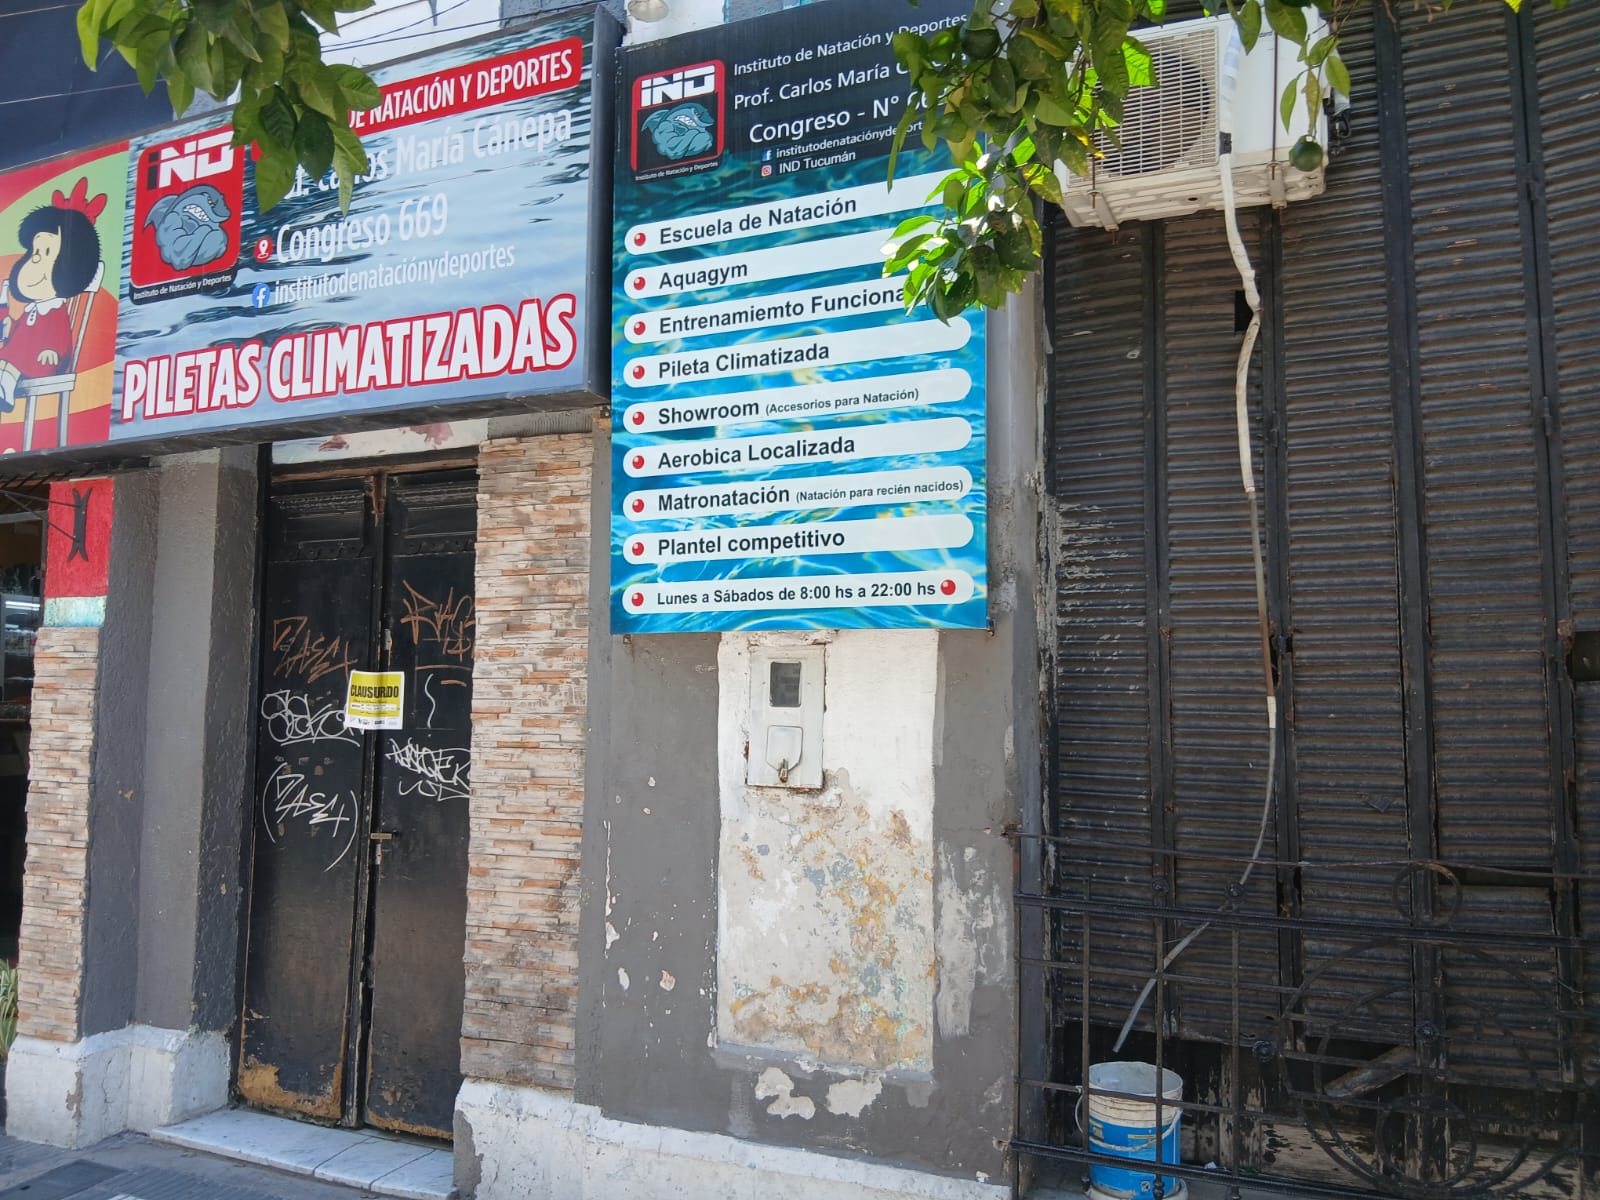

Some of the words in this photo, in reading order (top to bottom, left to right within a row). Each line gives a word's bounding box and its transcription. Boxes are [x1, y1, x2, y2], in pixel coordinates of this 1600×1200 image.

[734, 54, 791, 76] Instituto
[795, 48, 813, 62] de
[817, 32, 881, 57] Natación
[885, 32, 894, 45] y
[369, 76, 455, 125] NATACIÓN
[460, 73, 472, 103] Y
[476, 48, 573, 100] DEPORTES
[734, 87, 773, 110] Prof.
[779, 78, 832, 100] Carlos
[838, 63, 890, 88] María
[395, 126, 465, 176] María
[472, 108, 572, 159] Cánepa
[749, 110, 850, 143] Congreso
[779, 161, 801, 174] IND
[803, 151, 856, 169] Tucumán
[276, 212, 391, 263] Congreso
[400, 192, 449, 241] 669
[660, 218, 732, 245] Escuela
[739, 213, 762, 232] de
[768, 197, 857, 227] Natación
[133, 288, 159, 300] Instituto
[160, 286, 168, 294] de
[169, 281, 197, 293] Natación
[197, 281, 202, 289] y
[202, 274, 232, 287] Deportes
[274, 243, 515, 305] institutodenataciónydeportes
[659, 264, 748, 290] Aquagym
[811, 286, 904, 314] Funciona
[121, 339, 262, 422] PILETAS
[267, 293, 577, 402] CLIMATIZADAS
[659, 358, 709, 379] Pileta
[716, 343, 829, 371] Climatizada
[658, 402, 759, 425] Showroom
[765, 398, 831, 416] (Accesorios
[834, 395, 860, 409] para
[863, 388, 919, 405] Natación)
[658, 447, 742, 469] Aerobica
[748, 436, 855, 461] Localizada
[658, 485, 790, 512] Matronatación
[795, 488, 846, 504] (Natación
[849, 486, 873, 500] para
[876, 483, 911, 496] recién
[914, 479, 964, 494] nacidos)
[658, 535, 721, 556] Plantel
[727, 529, 845, 554] competitivo
[657, 592, 697, 606] Lunes
[702, 594, 709, 603] a
[713, 588, 774, 603] Sábados
[778, 588, 796, 600] de
[800, 586, 831, 600] 8:00
[835, 585, 853, 599] hs
[857, 588, 866, 598] a
[871, 582, 912, 597] 22:00
[916, 582, 936, 596] hs
